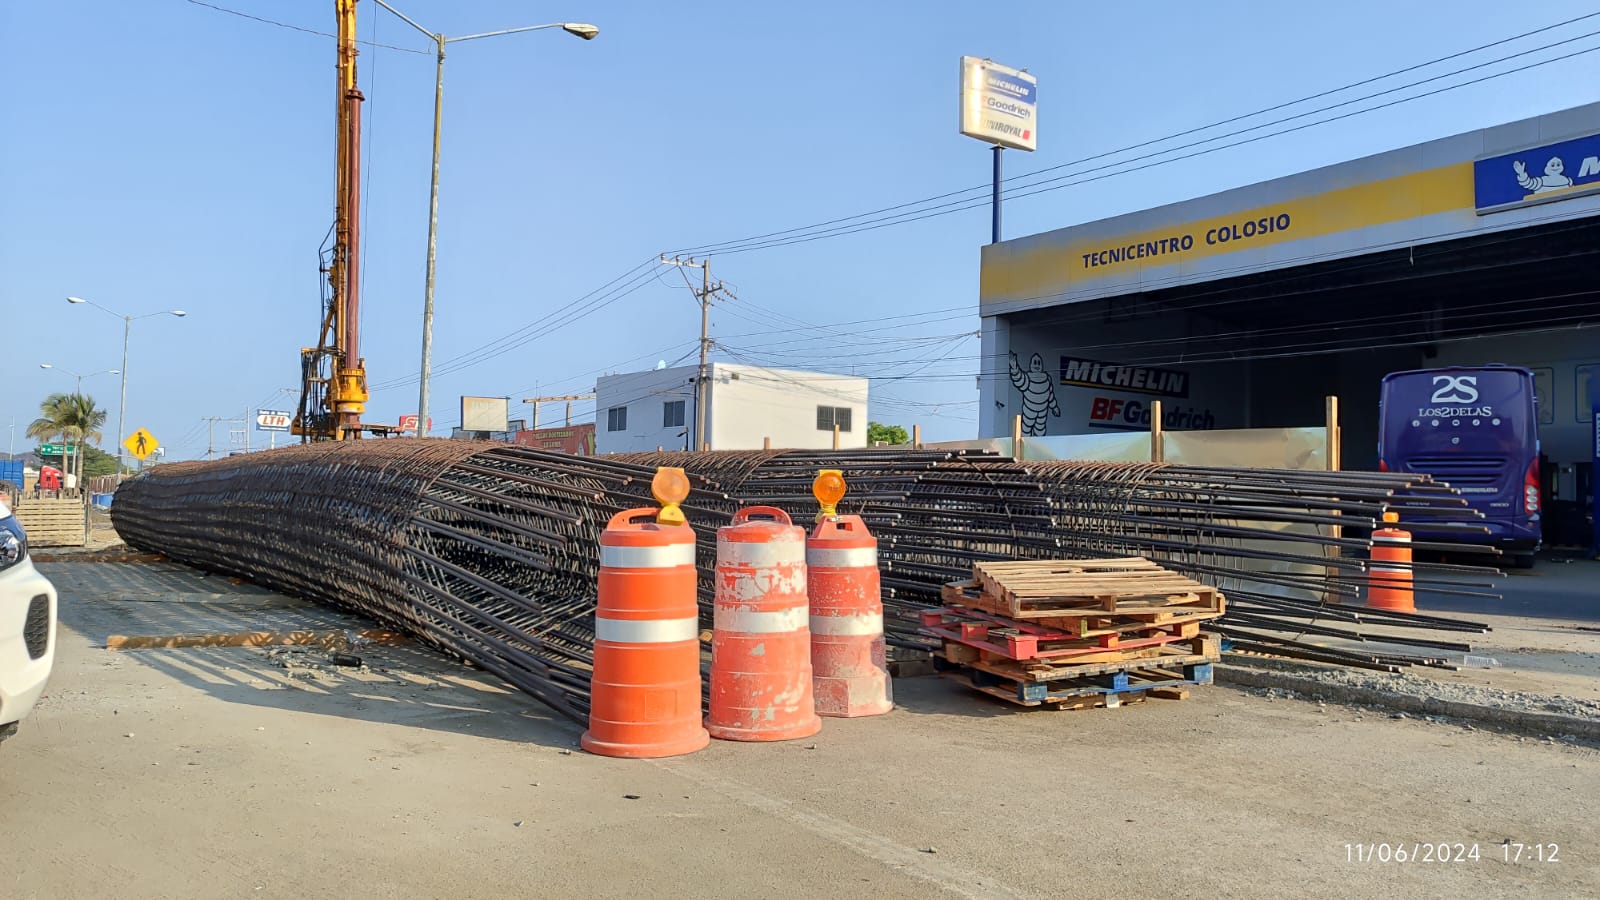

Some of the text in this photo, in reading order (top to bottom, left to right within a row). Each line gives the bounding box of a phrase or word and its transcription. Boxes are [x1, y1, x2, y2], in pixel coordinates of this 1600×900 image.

[987, 78, 1030, 96] MICHELIN
[1082, 213, 1291, 268] TECNICENTRO COLOSIO
[1065, 360, 1184, 393] MICHELIN
[1431, 375, 1479, 404] 2S
[262, 415, 285, 426] LTH
[1090, 397, 1215, 429] BFGodrich
[1419, 406, 1492, 418] LOS2DELAS
